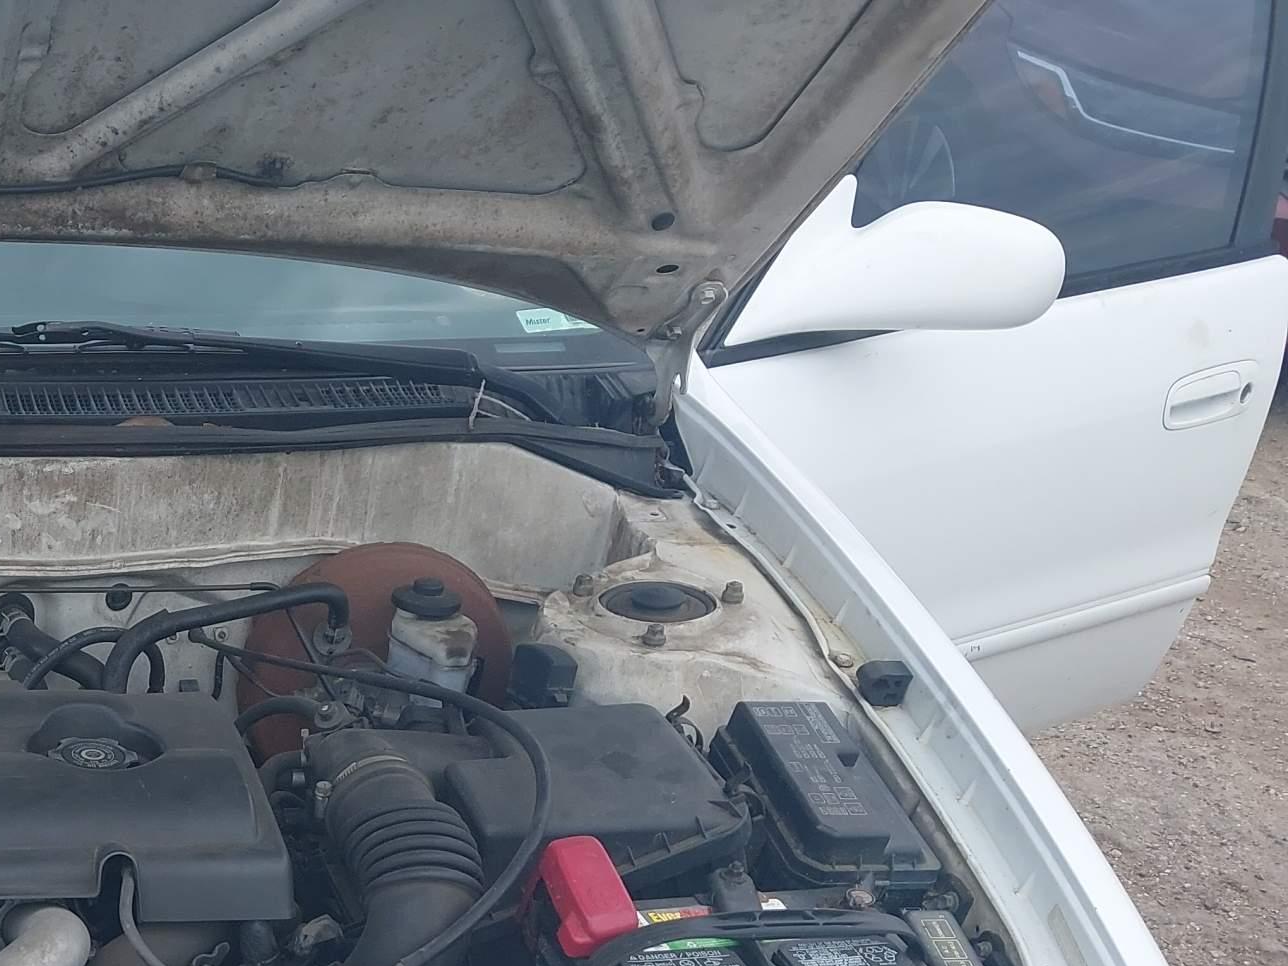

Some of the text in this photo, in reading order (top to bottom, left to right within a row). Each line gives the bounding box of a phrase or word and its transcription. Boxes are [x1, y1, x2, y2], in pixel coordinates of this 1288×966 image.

[525, 317, 551, 326] Mister
[638, 952, 678, 961] DANGER
[685, 950, 721, 958] POISON
